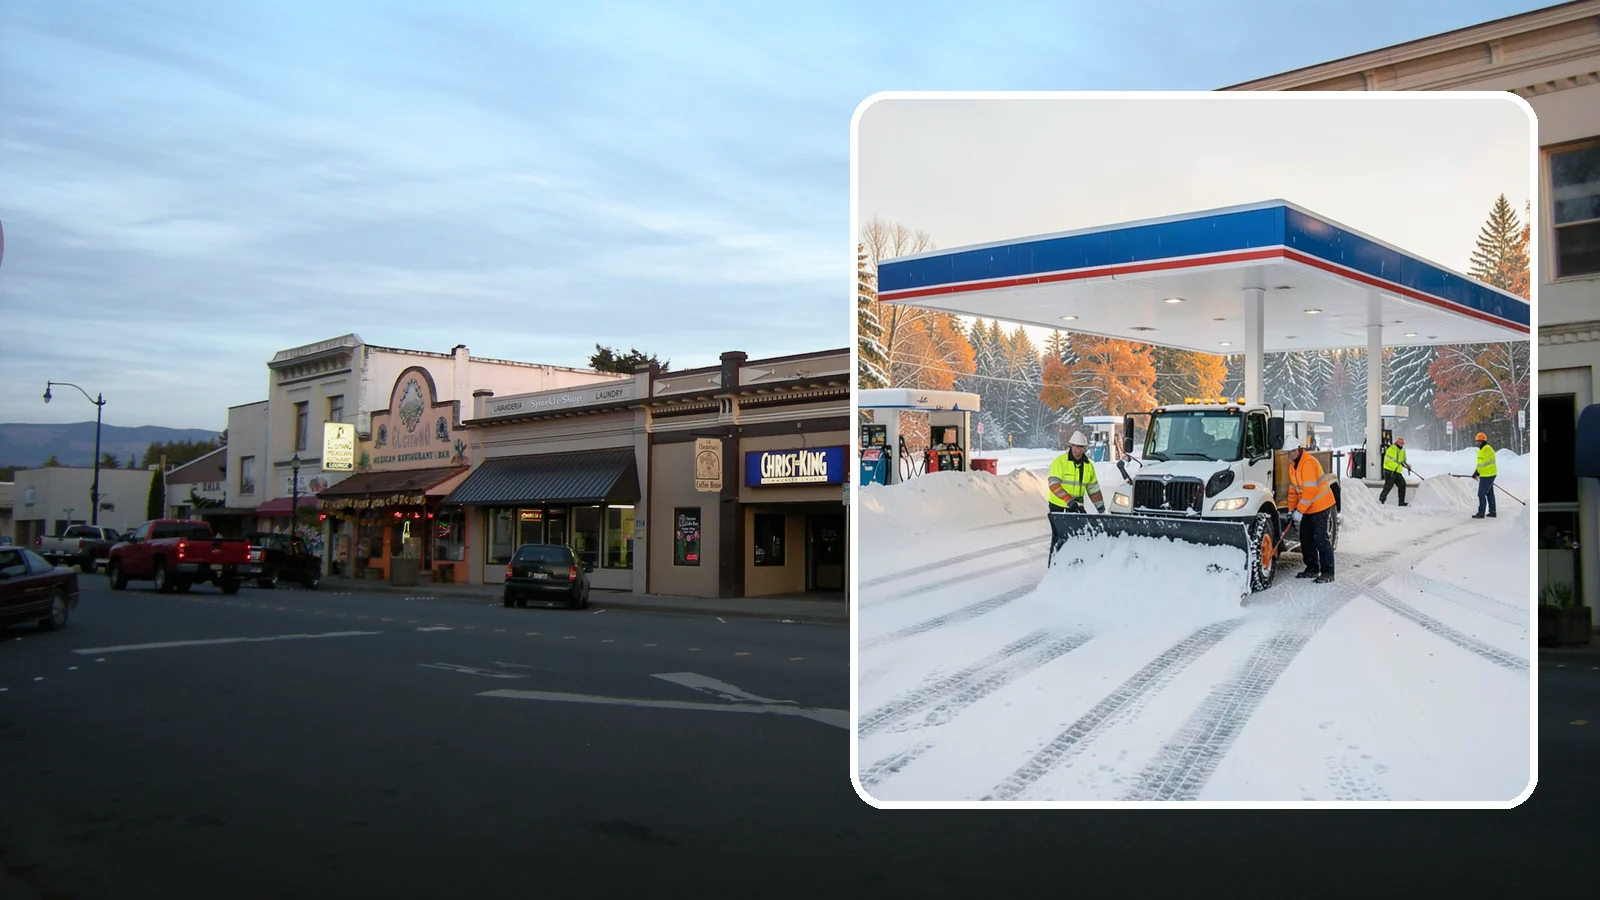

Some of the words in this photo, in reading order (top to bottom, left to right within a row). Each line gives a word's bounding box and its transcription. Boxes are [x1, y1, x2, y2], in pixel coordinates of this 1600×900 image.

[494, 402, 523, 412] LAVANDERIA
[531, 397, 560, 409] Sparkle
[560, 393, 582, 404] Shop
[595, 389, 623, 400] LAUNDRY
[374, 456, 396, 464] MEXICAN
[397, 452, 433, 462] RESTAURANT
[438, 450, 450, 459] BAR
